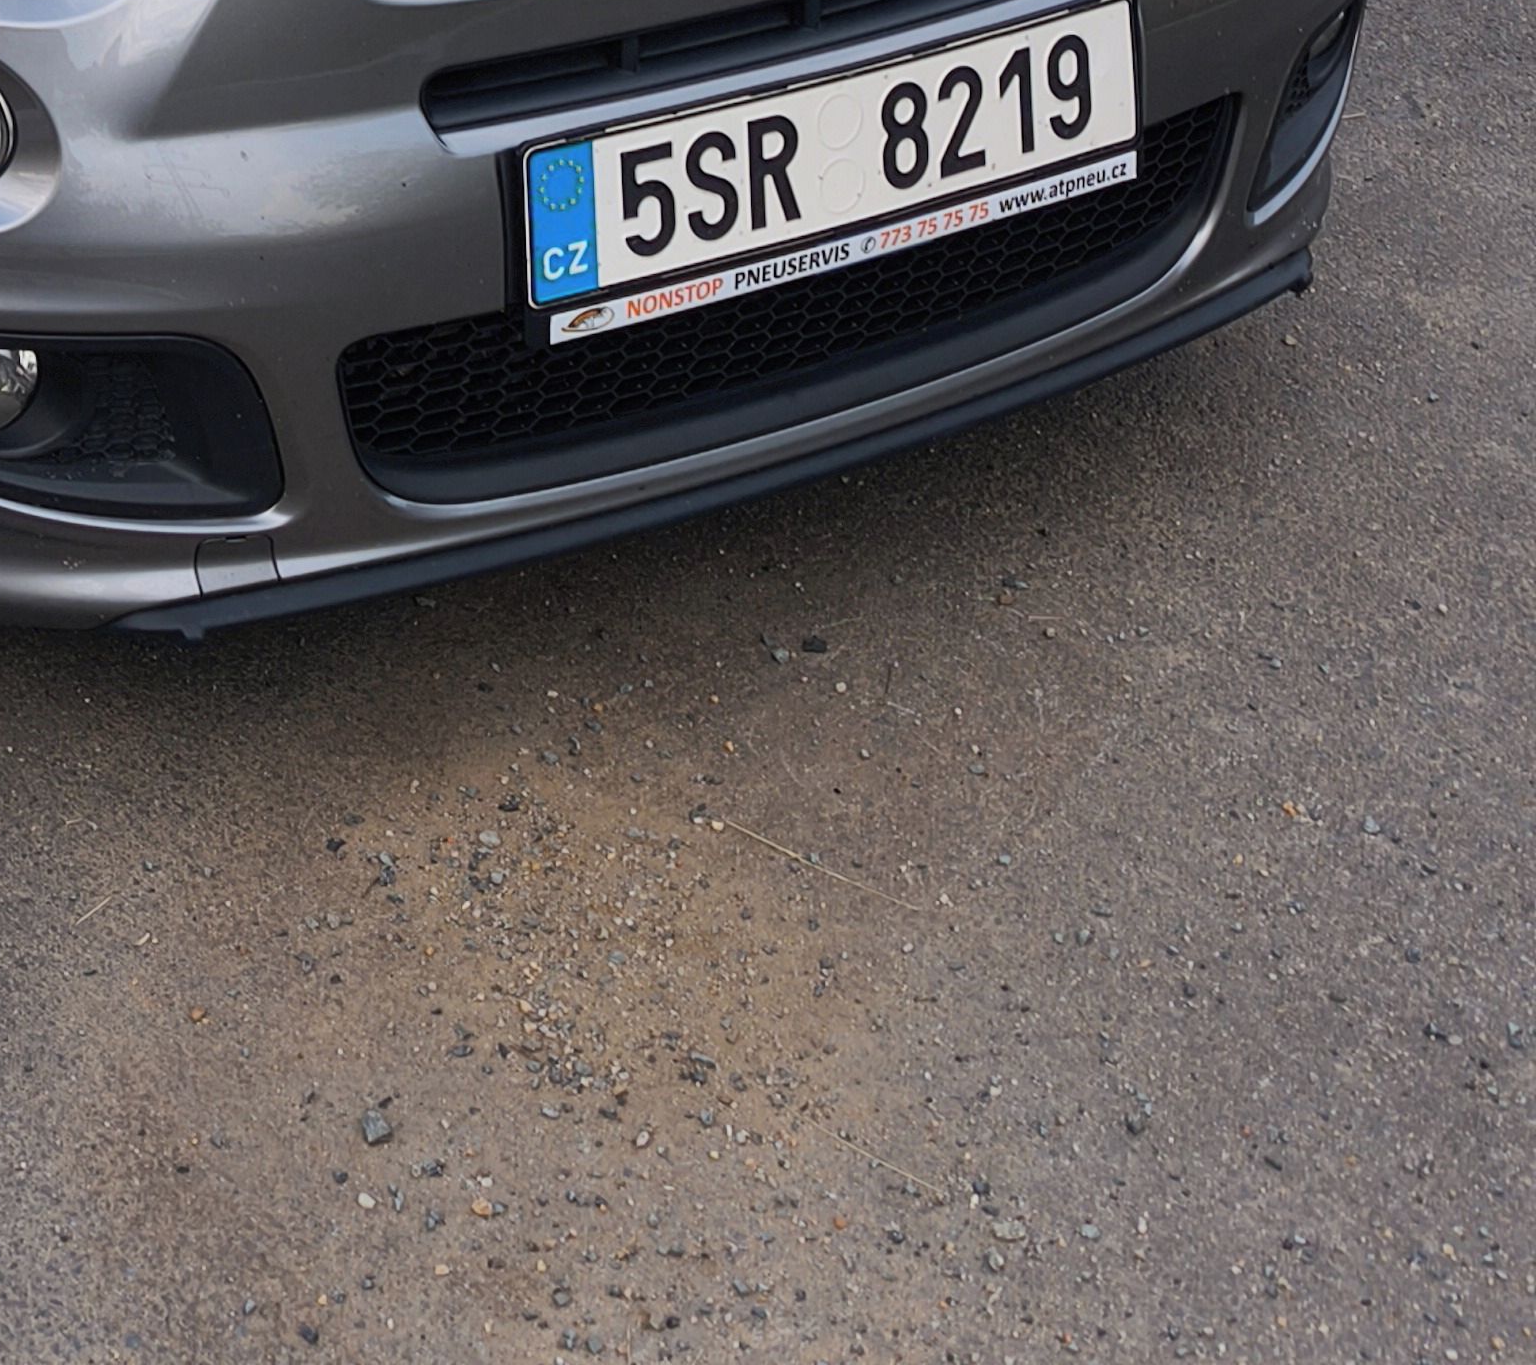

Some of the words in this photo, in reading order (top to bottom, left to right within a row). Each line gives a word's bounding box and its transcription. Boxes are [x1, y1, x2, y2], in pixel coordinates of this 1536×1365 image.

[620, 114, 802, 257] 5SR
[880, 33, 1093, 190] 8219
[543, 239, 589, 281] CZ
[626, 277, 724, 319] NONSTOP
[733, 243, 851, 290] PNEUSERVIS
[879, 225, 913, 250] 773
[917, 217, 938, 239] 75
[943, 210, 964, 231] 75
[968, 201, 990, 223] 75
[999, 161, 1128, 213] www.atpneu.cz
